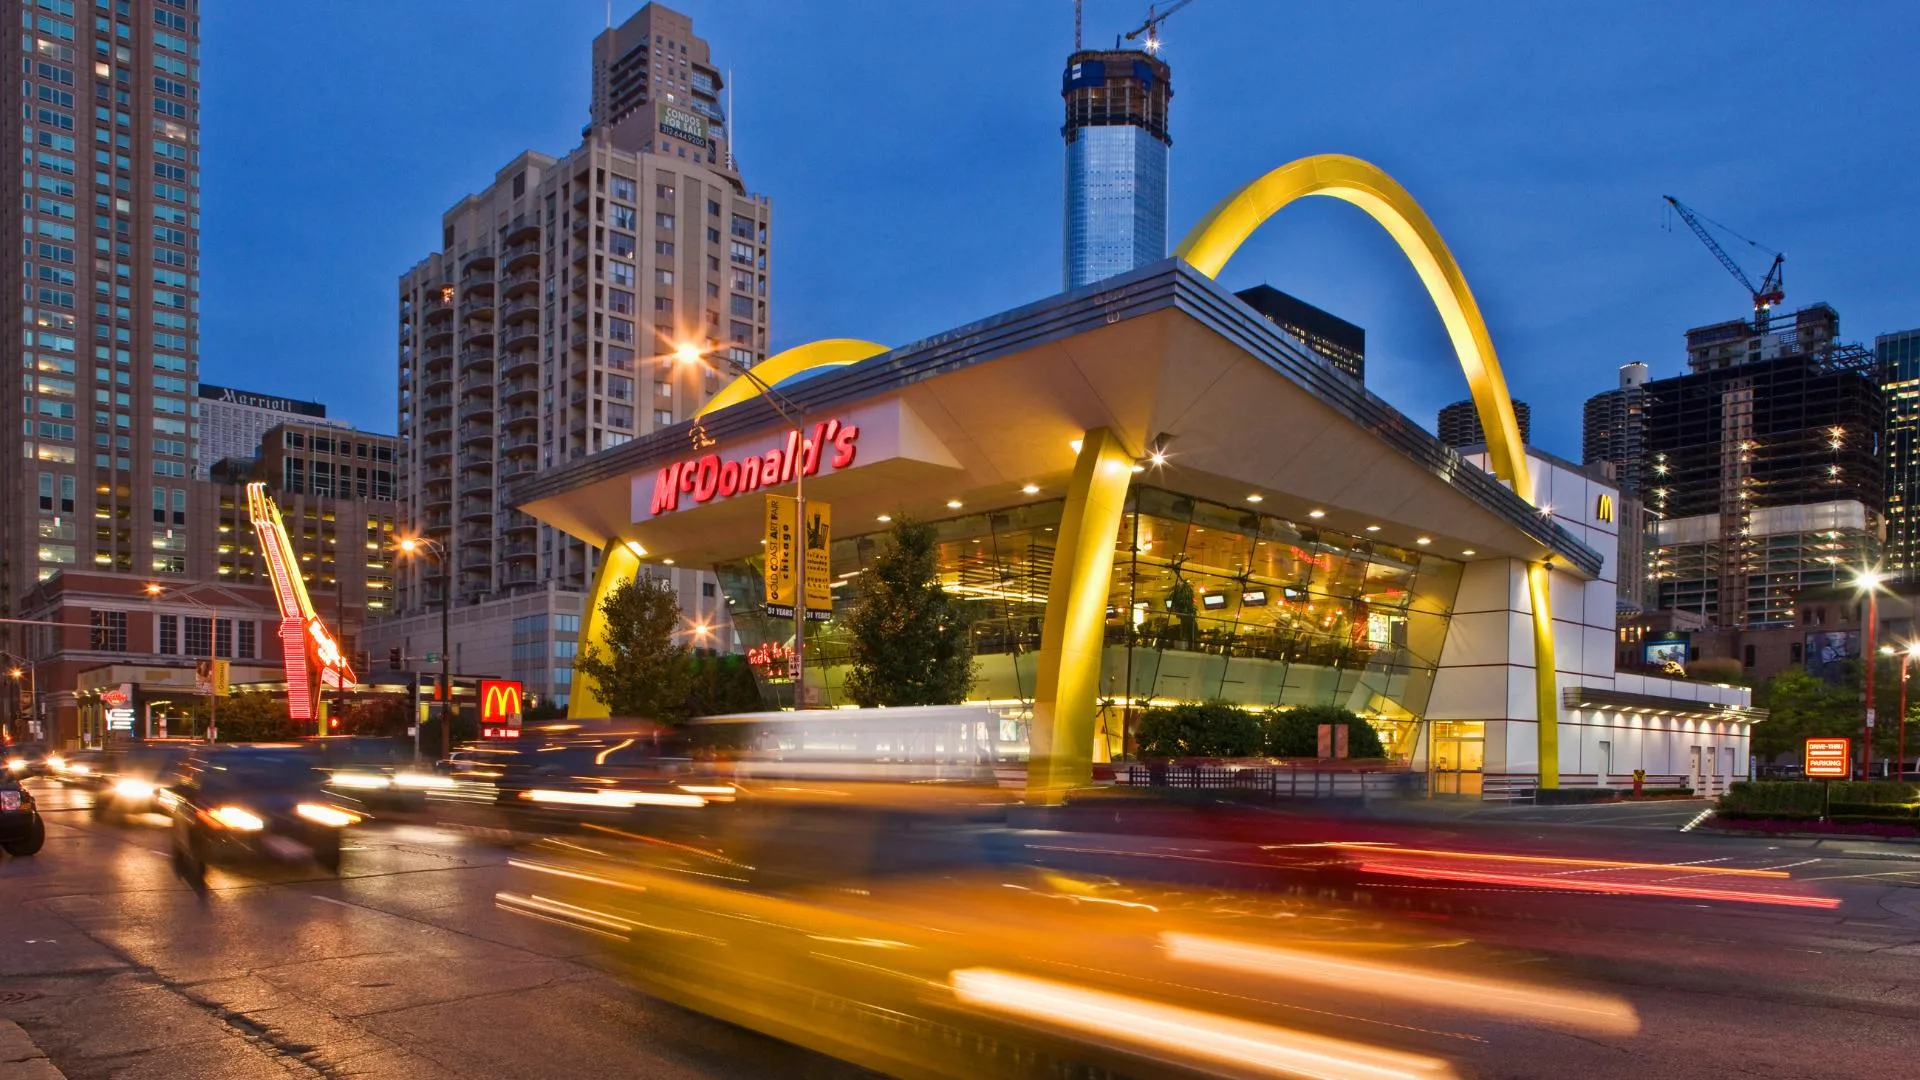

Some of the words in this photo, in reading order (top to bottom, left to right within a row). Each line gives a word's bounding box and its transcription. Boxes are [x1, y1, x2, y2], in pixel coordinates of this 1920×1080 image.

[665, 115, 681, 129] FOR
[683, 122, 702, 137] SALE
[666, 108, 700, 127] CONDOS
[218, 388, 292, 412] Marriott
[651, 419, 860, 515] McDonald's
[771, 501, 779, 520] FAIR
[770, 521, 779, 540] ART
[770, 542, 779, 572] COAST
[780, 524, 791, 580] chicago
[770, 573, 779, 600] GOLD
[768, 606, 775, 615] 51
[776, 607, 793, 617] YEARS
[814, 611, 831, 620] YEARS
